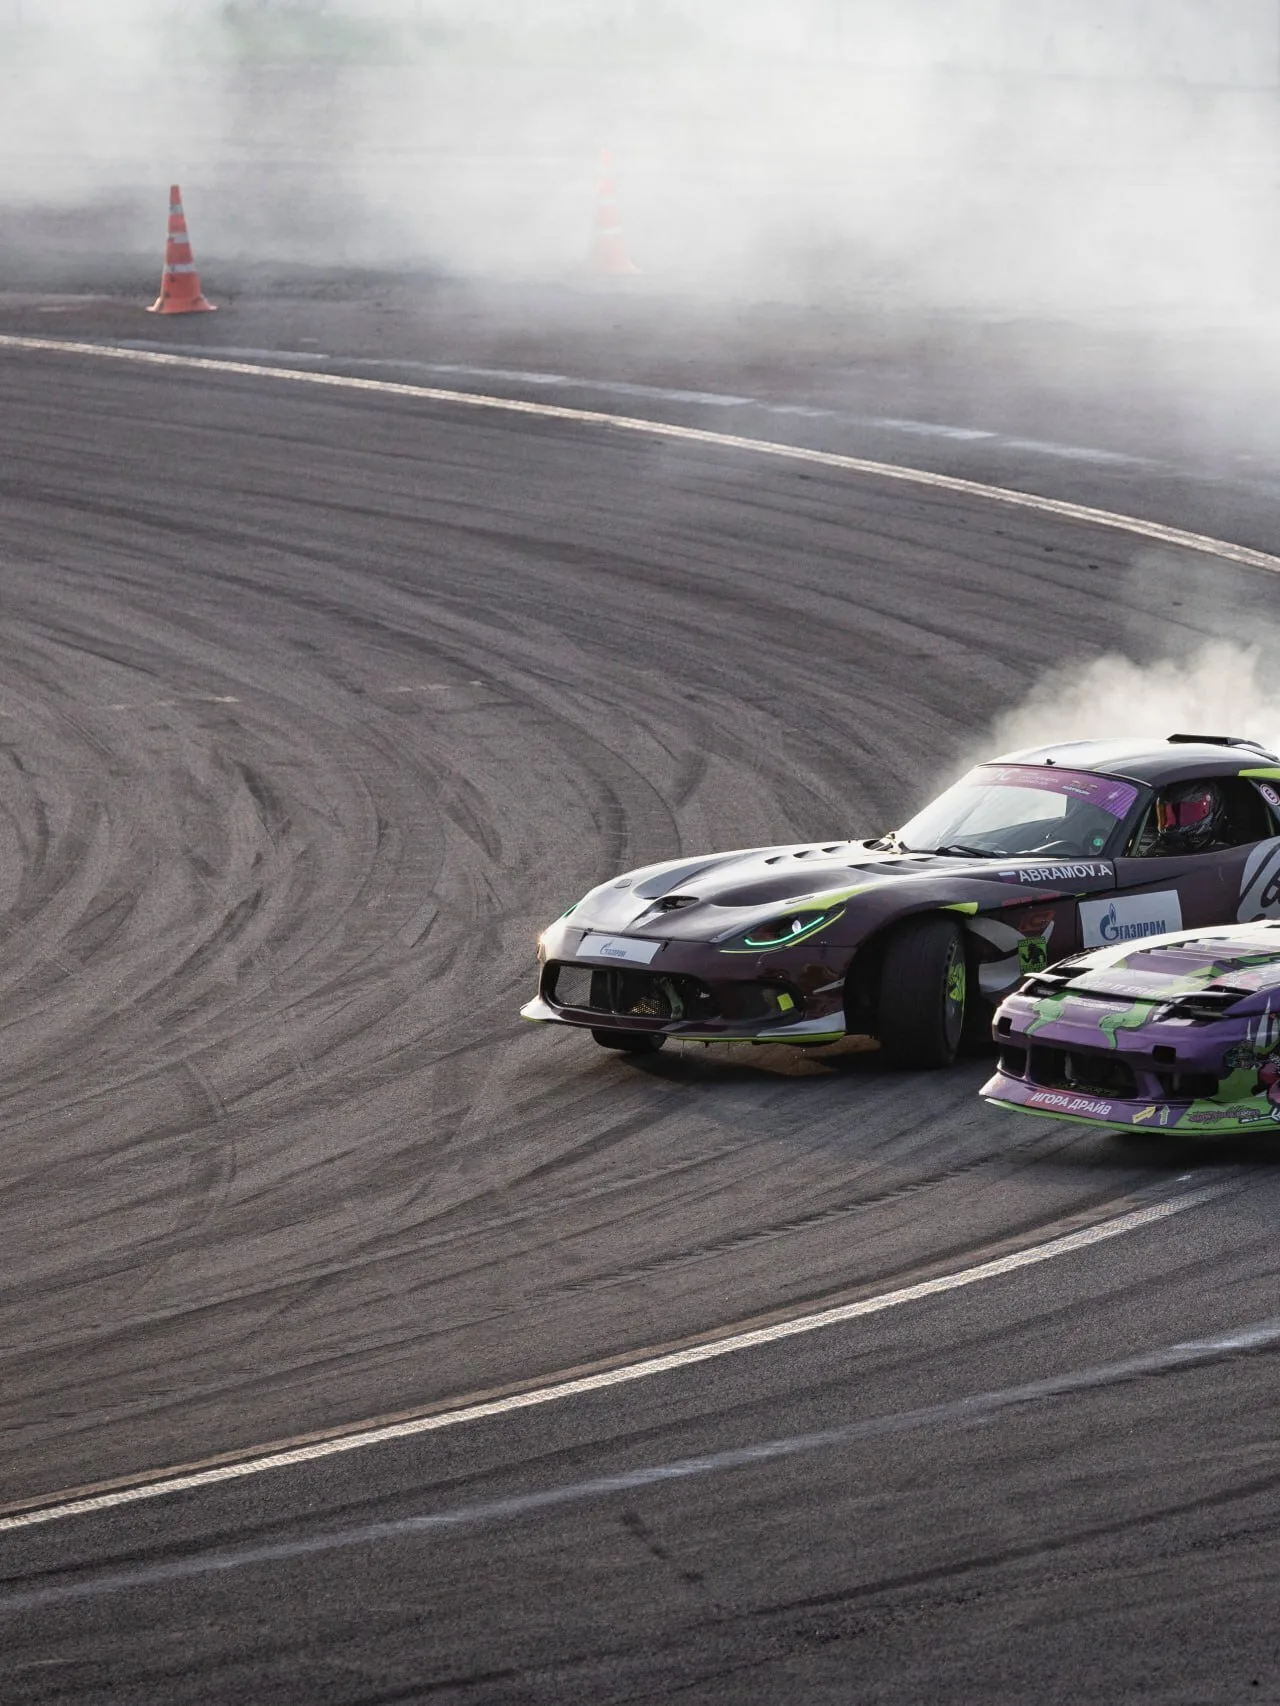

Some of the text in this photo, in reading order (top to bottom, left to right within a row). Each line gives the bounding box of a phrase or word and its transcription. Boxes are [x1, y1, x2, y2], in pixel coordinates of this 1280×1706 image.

[1019, 864, 1113, 883] ABRAMOV.A
[1118, 919, 1166, 940] ГАЗПРОМ
[1030, 1092, 1113, 1116] ИГОРА ДРАЙВ
